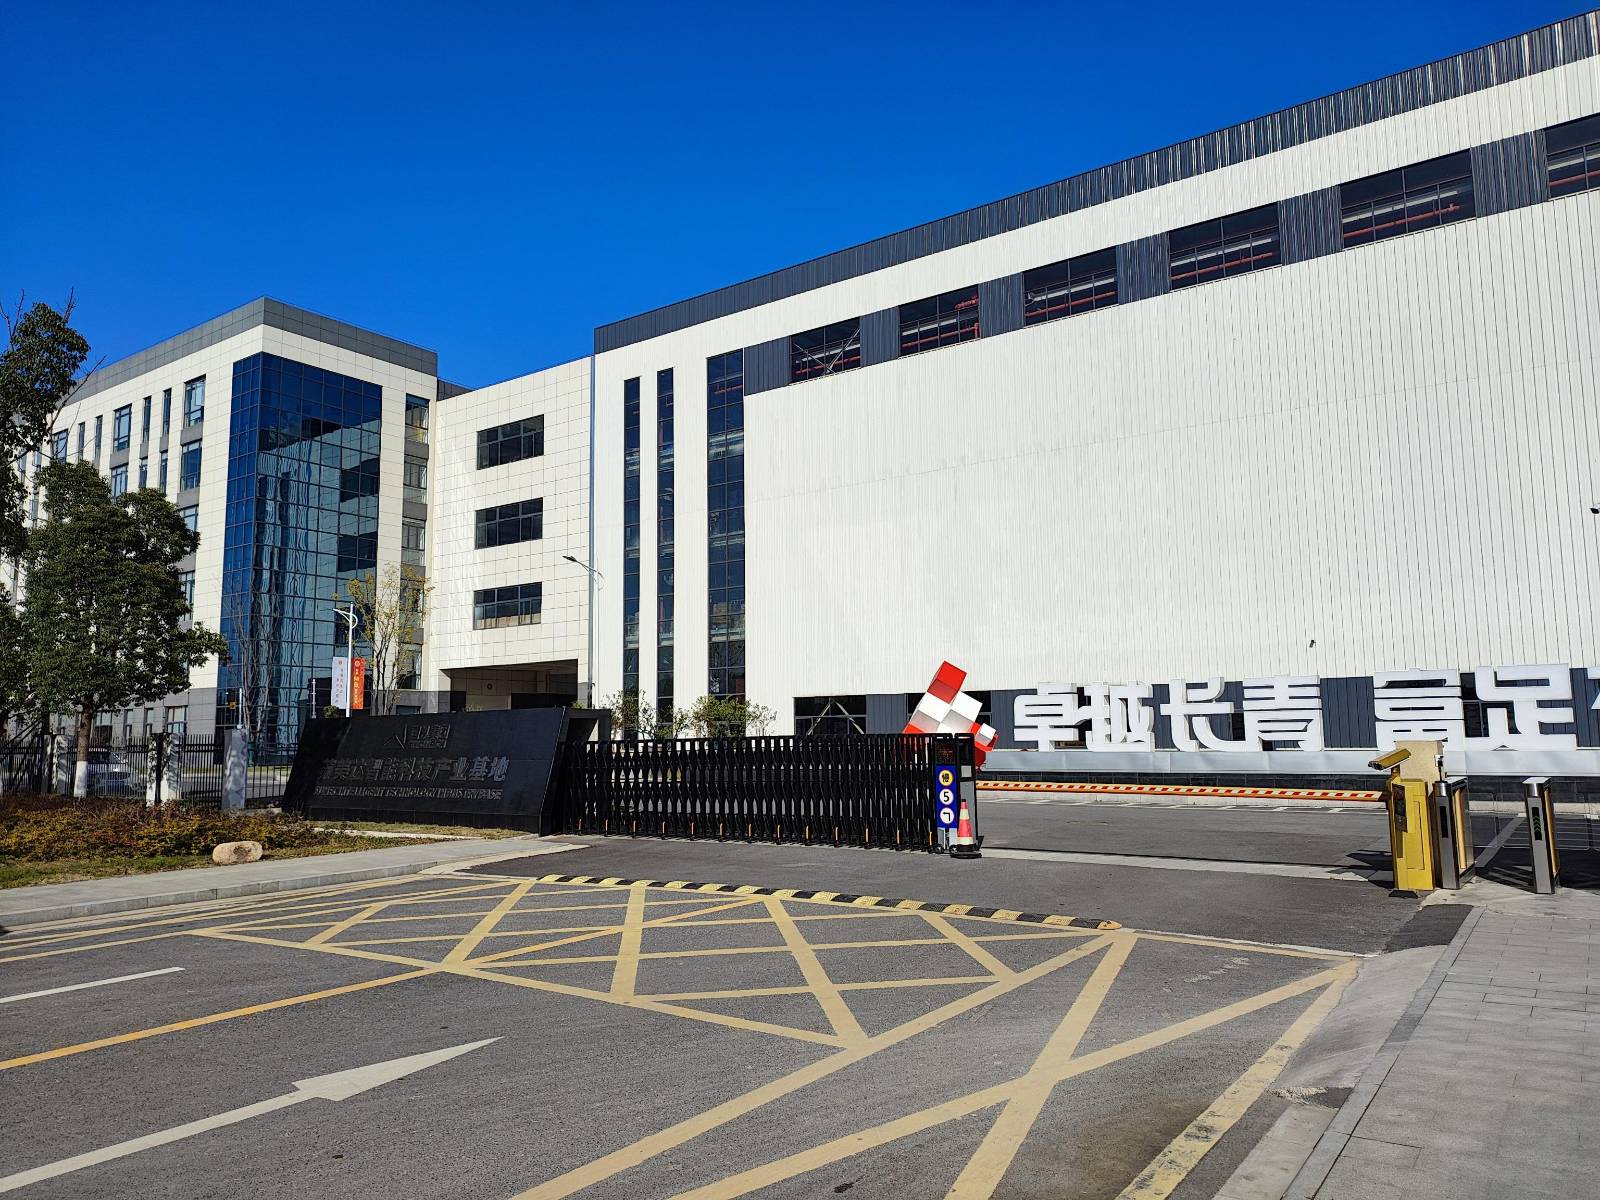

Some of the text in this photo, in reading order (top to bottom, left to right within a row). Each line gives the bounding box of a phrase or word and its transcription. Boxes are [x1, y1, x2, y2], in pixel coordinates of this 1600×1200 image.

[1013, 674, 1323, 752] 卓越长青
[943, 791, 949, 802] 5
